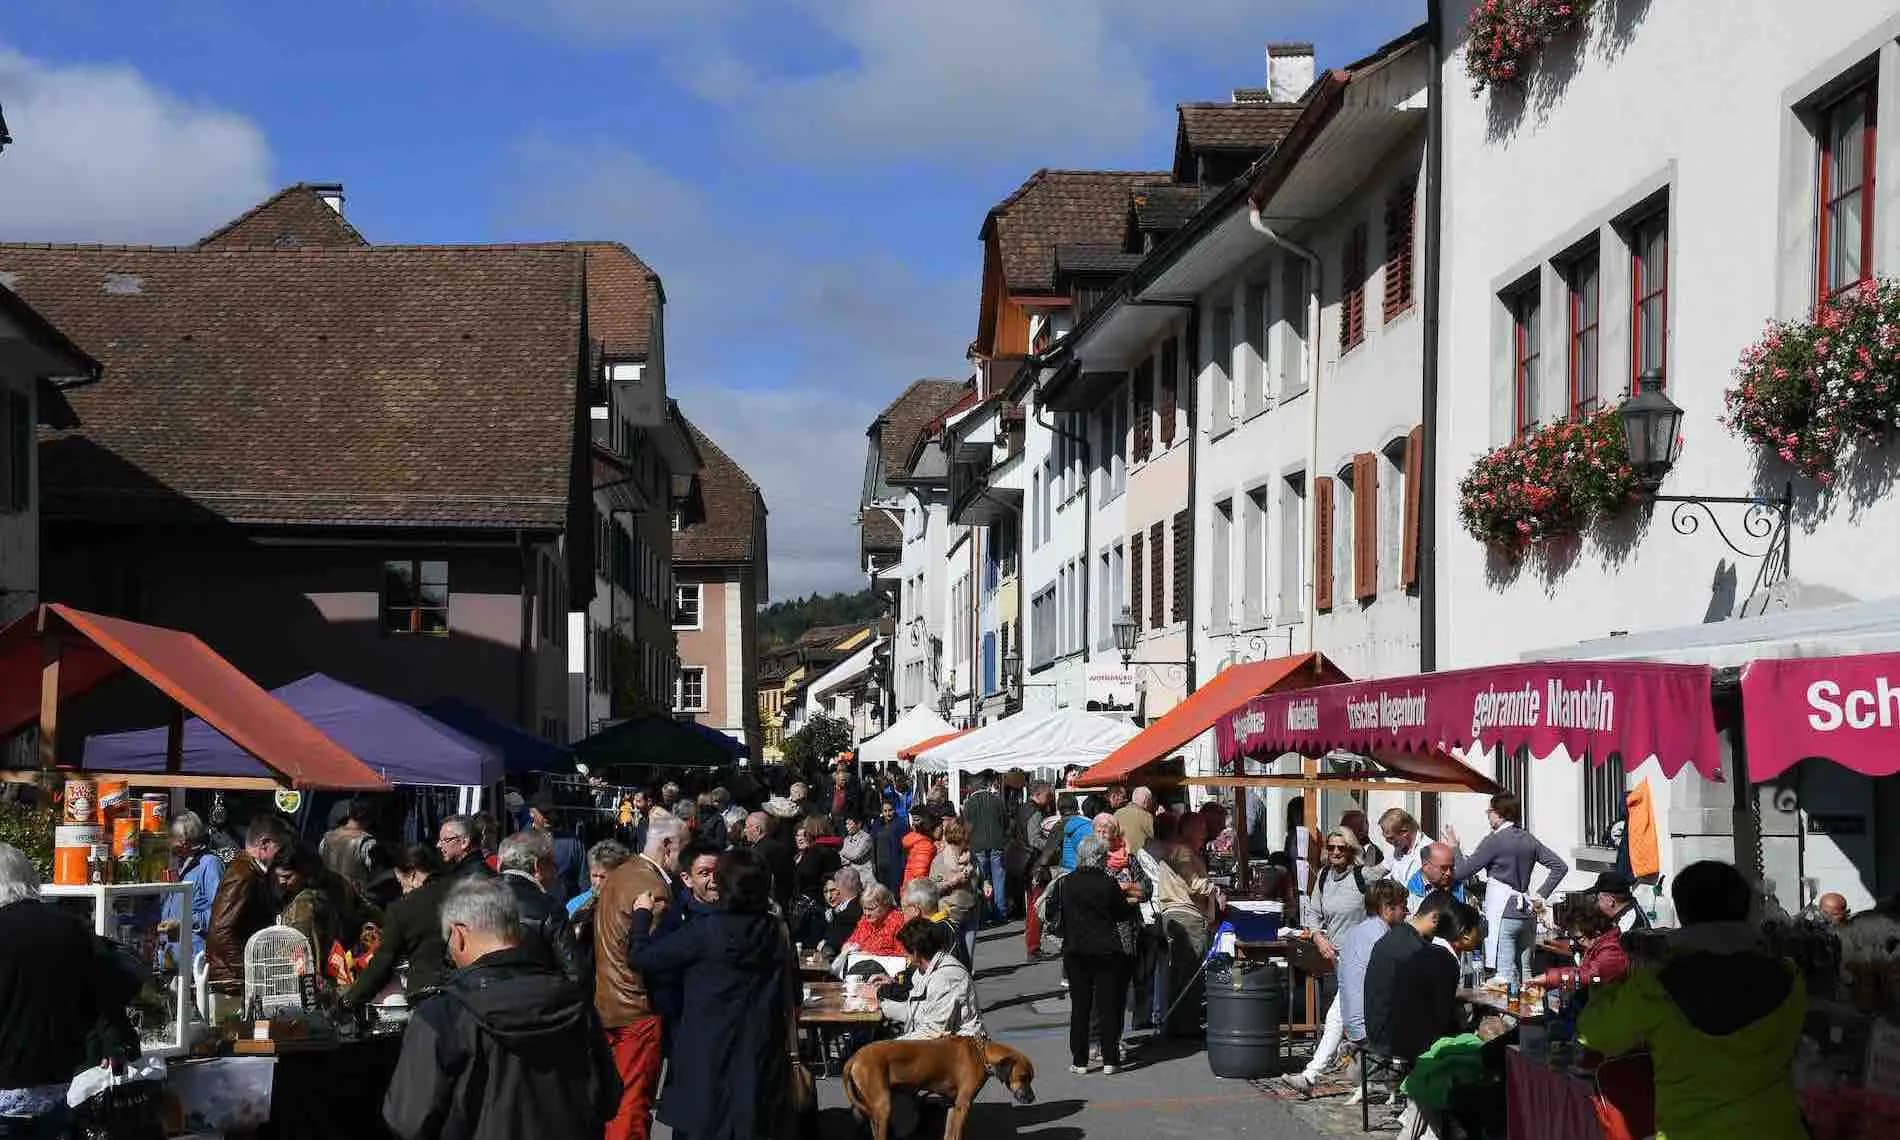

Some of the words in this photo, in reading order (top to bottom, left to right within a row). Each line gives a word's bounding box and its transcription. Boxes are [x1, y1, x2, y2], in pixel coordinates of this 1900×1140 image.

[1347, 696, 1378, 729] frisches
[1380, 690, 1426, 735] Magenbrot
[1472, 682, 1540, 737] gebrannte
[1806, 677, 1900, 731] Sch
